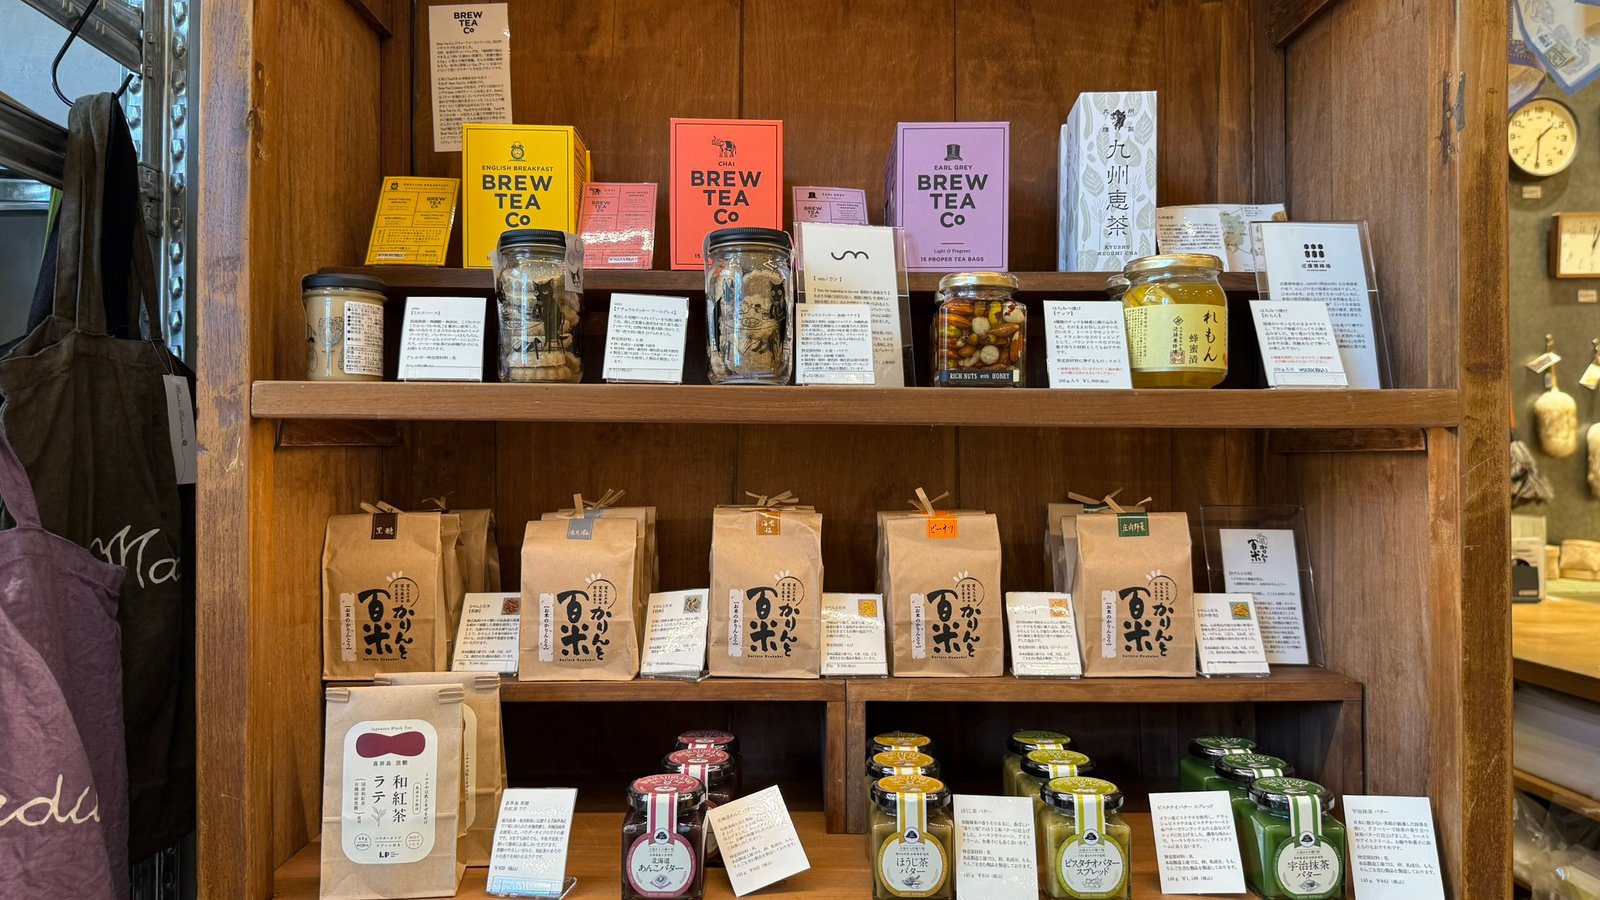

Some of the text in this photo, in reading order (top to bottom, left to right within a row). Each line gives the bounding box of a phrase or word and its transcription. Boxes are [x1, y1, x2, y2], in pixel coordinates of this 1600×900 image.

[482, 175, 553, 192] BREW
[691, 171, 761, 187] BREW
[918, 174, 988, 190] BREW
[1106, 139, 1131, 236] 九州恵茶
[495, 193, 541, 210] TEA
[703, 190, 750, 206] TEA
[930, 193, 976, 209] TEA
[505, 212, 531, 228] Co
[714, 209, 739, 224] Co
[940, 212, 966, 228] Co
[1203, 310, 1218, 362] れもん
[1189, 334, 1198, 364] 蜂蜜漬
[1122, 522, 1146, 532] 庄内野菜
[1248, 539, 1261, 562] 百米
[358, 589, 393, 655] 百米
[557, 590, 590, 656] 百米
[746, 586, 778, 652] 百米
[927, 589, 960, 653] 百米
[1118, 587, 1152, 652] 百米
[392, 605, 415, 659] かりんと
[590, 606, 612, 660] かりんと
[779, 603, 800, 657] かりんと
[960, 604, 981, 657] かりんと
[1153, 602, 1174, 657] かりんと
[372, 775, 386, 804] ラテ
[392, 774, 407, 822] 和紅茶
[638, 865, 683, 873] あんこバター
[897, 857, 928, 867] ほうじ茶
[1065, 859, 1120, 868] ピスタチオバター
[1288, 860, 1329, 871] 宇治抹茶
[900, 867, 925, 875] バター
[1077, 867, 1109, 876] スプレッド
[1297, 871, 1322, 879] バター
